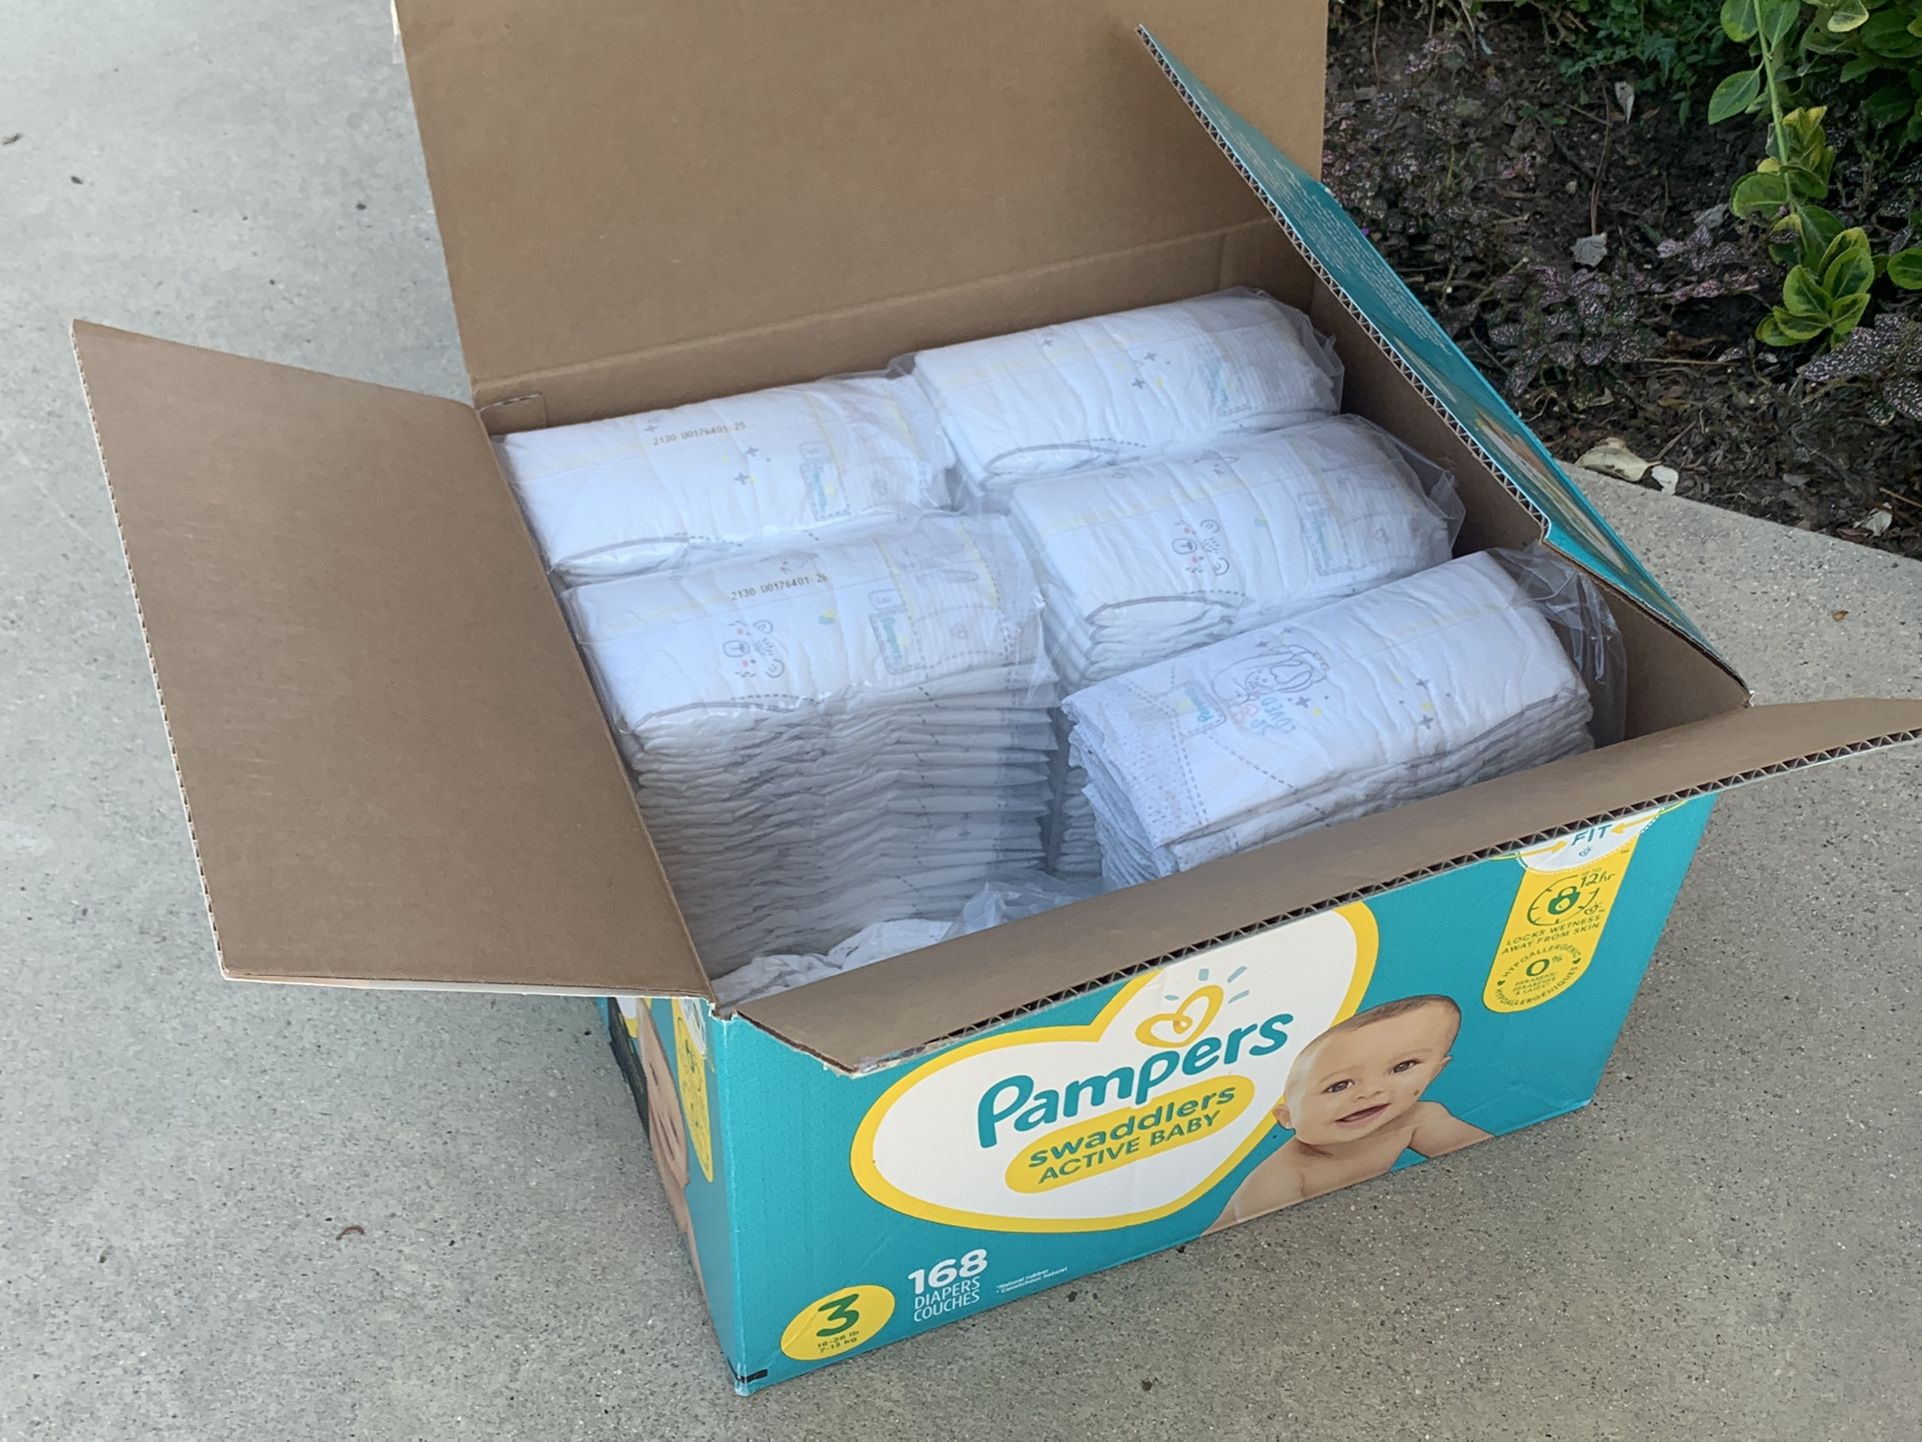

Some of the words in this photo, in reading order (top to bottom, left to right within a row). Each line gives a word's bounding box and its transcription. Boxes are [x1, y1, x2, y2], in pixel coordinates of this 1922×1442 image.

[1571, 824, 1612, 846] FIT
[1501, 941, 1535, 955] AWAY
[1537, 931, 1570, 943] FROM
[1573, 922, 1600, 935] SKIN
[1506, 929, 1546, 946] LOCKS
[1549, 915, 1600, 934] WETNESS
[977, 1013, 1294, 1148] Pampers
[1028, 1086, 1236, 1168] swaddlers
[1038, 1137, 1141, 1185] ACTIVE
[1150, 1110, 1221, 1147] BABY
[907, 1248, 988, 1294] 168
[914, 1276, 980, 1310] DIAPERS
[914, 1289, 980, 1322] COUCHES
[816, 1293, 859, 1337] 3
